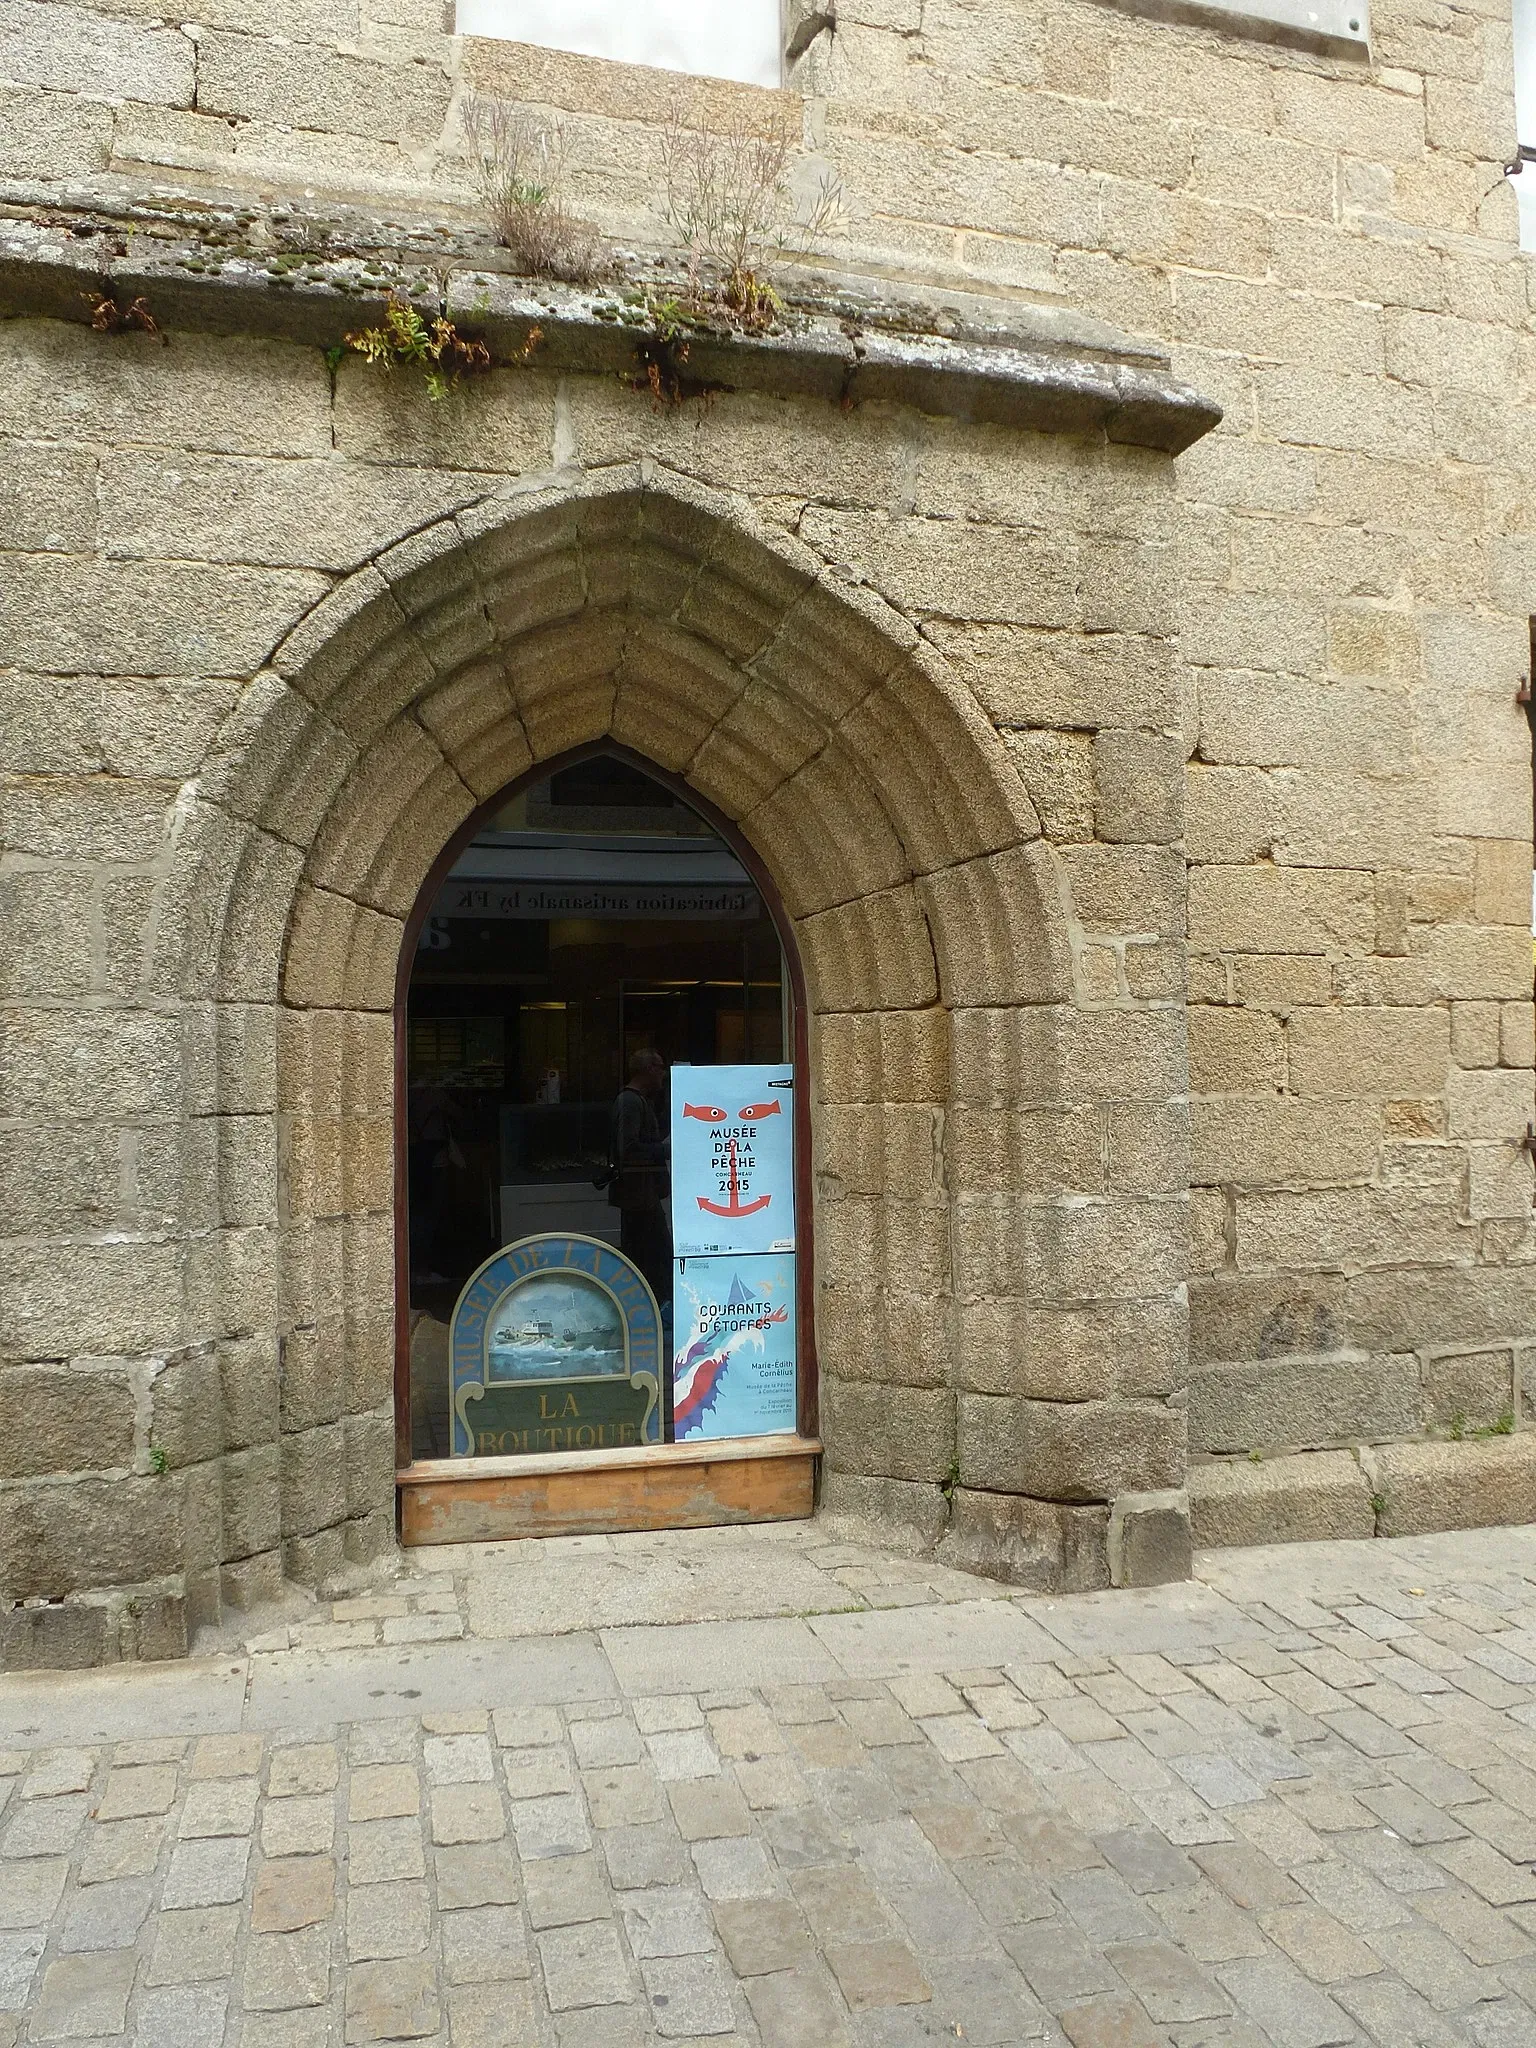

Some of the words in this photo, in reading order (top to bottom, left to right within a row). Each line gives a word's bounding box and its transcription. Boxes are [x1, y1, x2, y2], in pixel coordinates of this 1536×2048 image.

[709, 1124, 757, 1139] MUSÉE
[714, 1141, 731, 1153] DE
[736, 1141, 752, 1153] LA
[711, 1154, 756, 1169] PÊCHE
[718, 1179, 750, 1192] 2015
[505, 1241, 549, 1276] DE
[562, 1240, 603, 1275] LA
[699, 1302, 772, 1317] COURANTS
[699, 1316, 772, 1333] D'ÉTOFFES
[751, 1359, 793, 1370] Marie-Édith
[759, 1369, 793, 1378] Cornélius
[538, 1391, 581, 1419] LA
[477, 1422, 636, 1457] BOUTIQUE
